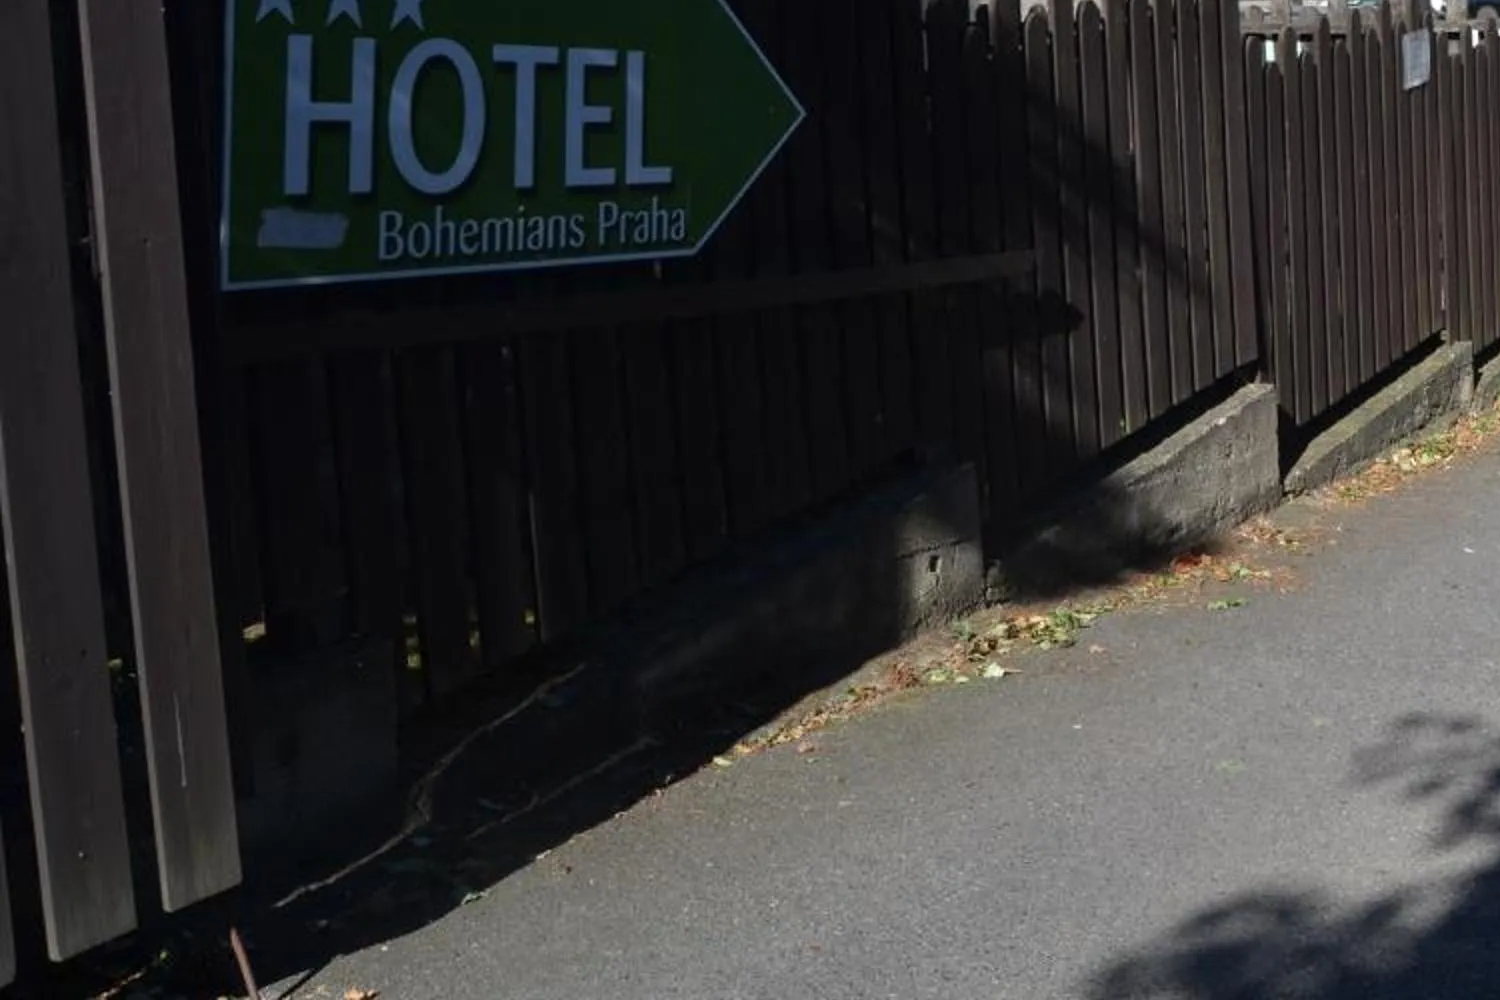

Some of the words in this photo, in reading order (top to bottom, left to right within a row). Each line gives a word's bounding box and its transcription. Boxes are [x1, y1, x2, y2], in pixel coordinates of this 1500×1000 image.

[283, 34, 673, 195] HOTEL
[378, 204, 586, 260] Bohemians
[598, 196, 686, 246] Praha
